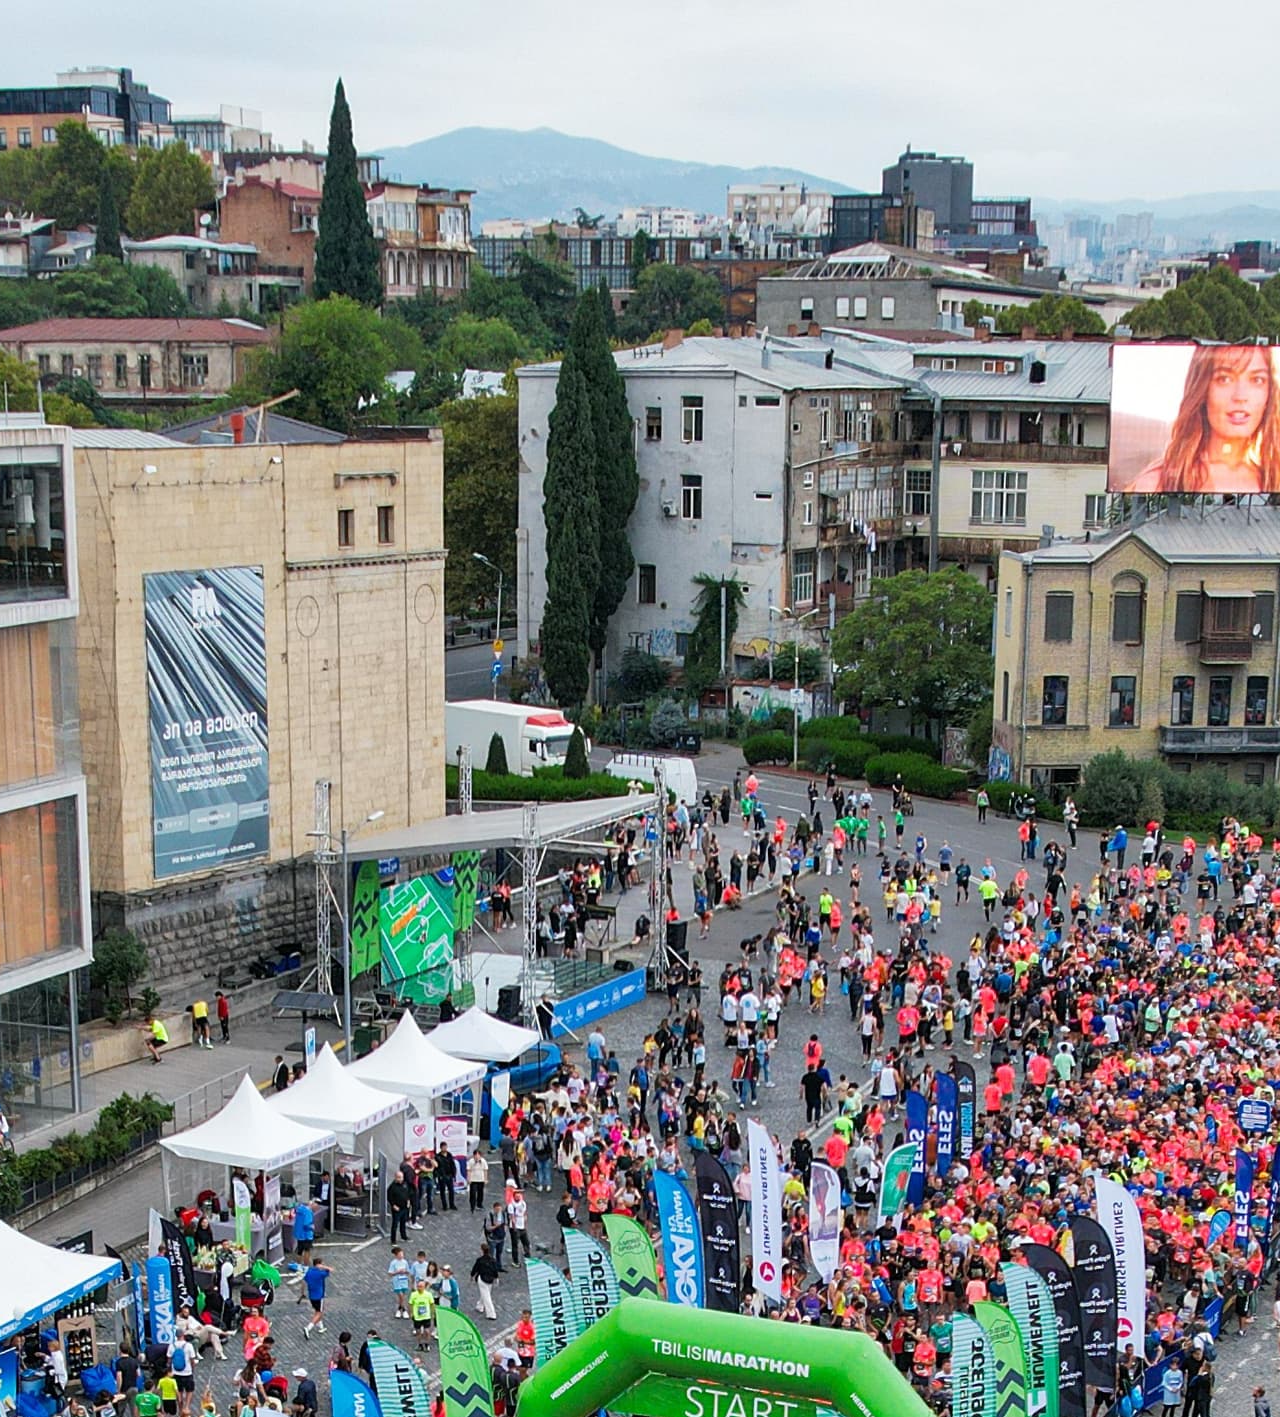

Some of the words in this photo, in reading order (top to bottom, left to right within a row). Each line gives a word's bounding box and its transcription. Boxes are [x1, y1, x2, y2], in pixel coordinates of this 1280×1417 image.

[163, 721, 181, 740] პი
[184, 719, 202, 737] ემ
[206, 711, 258, 734] მეტალი
[156, 1300, 175, 1345] OKA
[550, 1349, 610, 1401] HEIDELBERGCEMENT
[650, 1338, 810, 1378] TBILISIMARATHON
